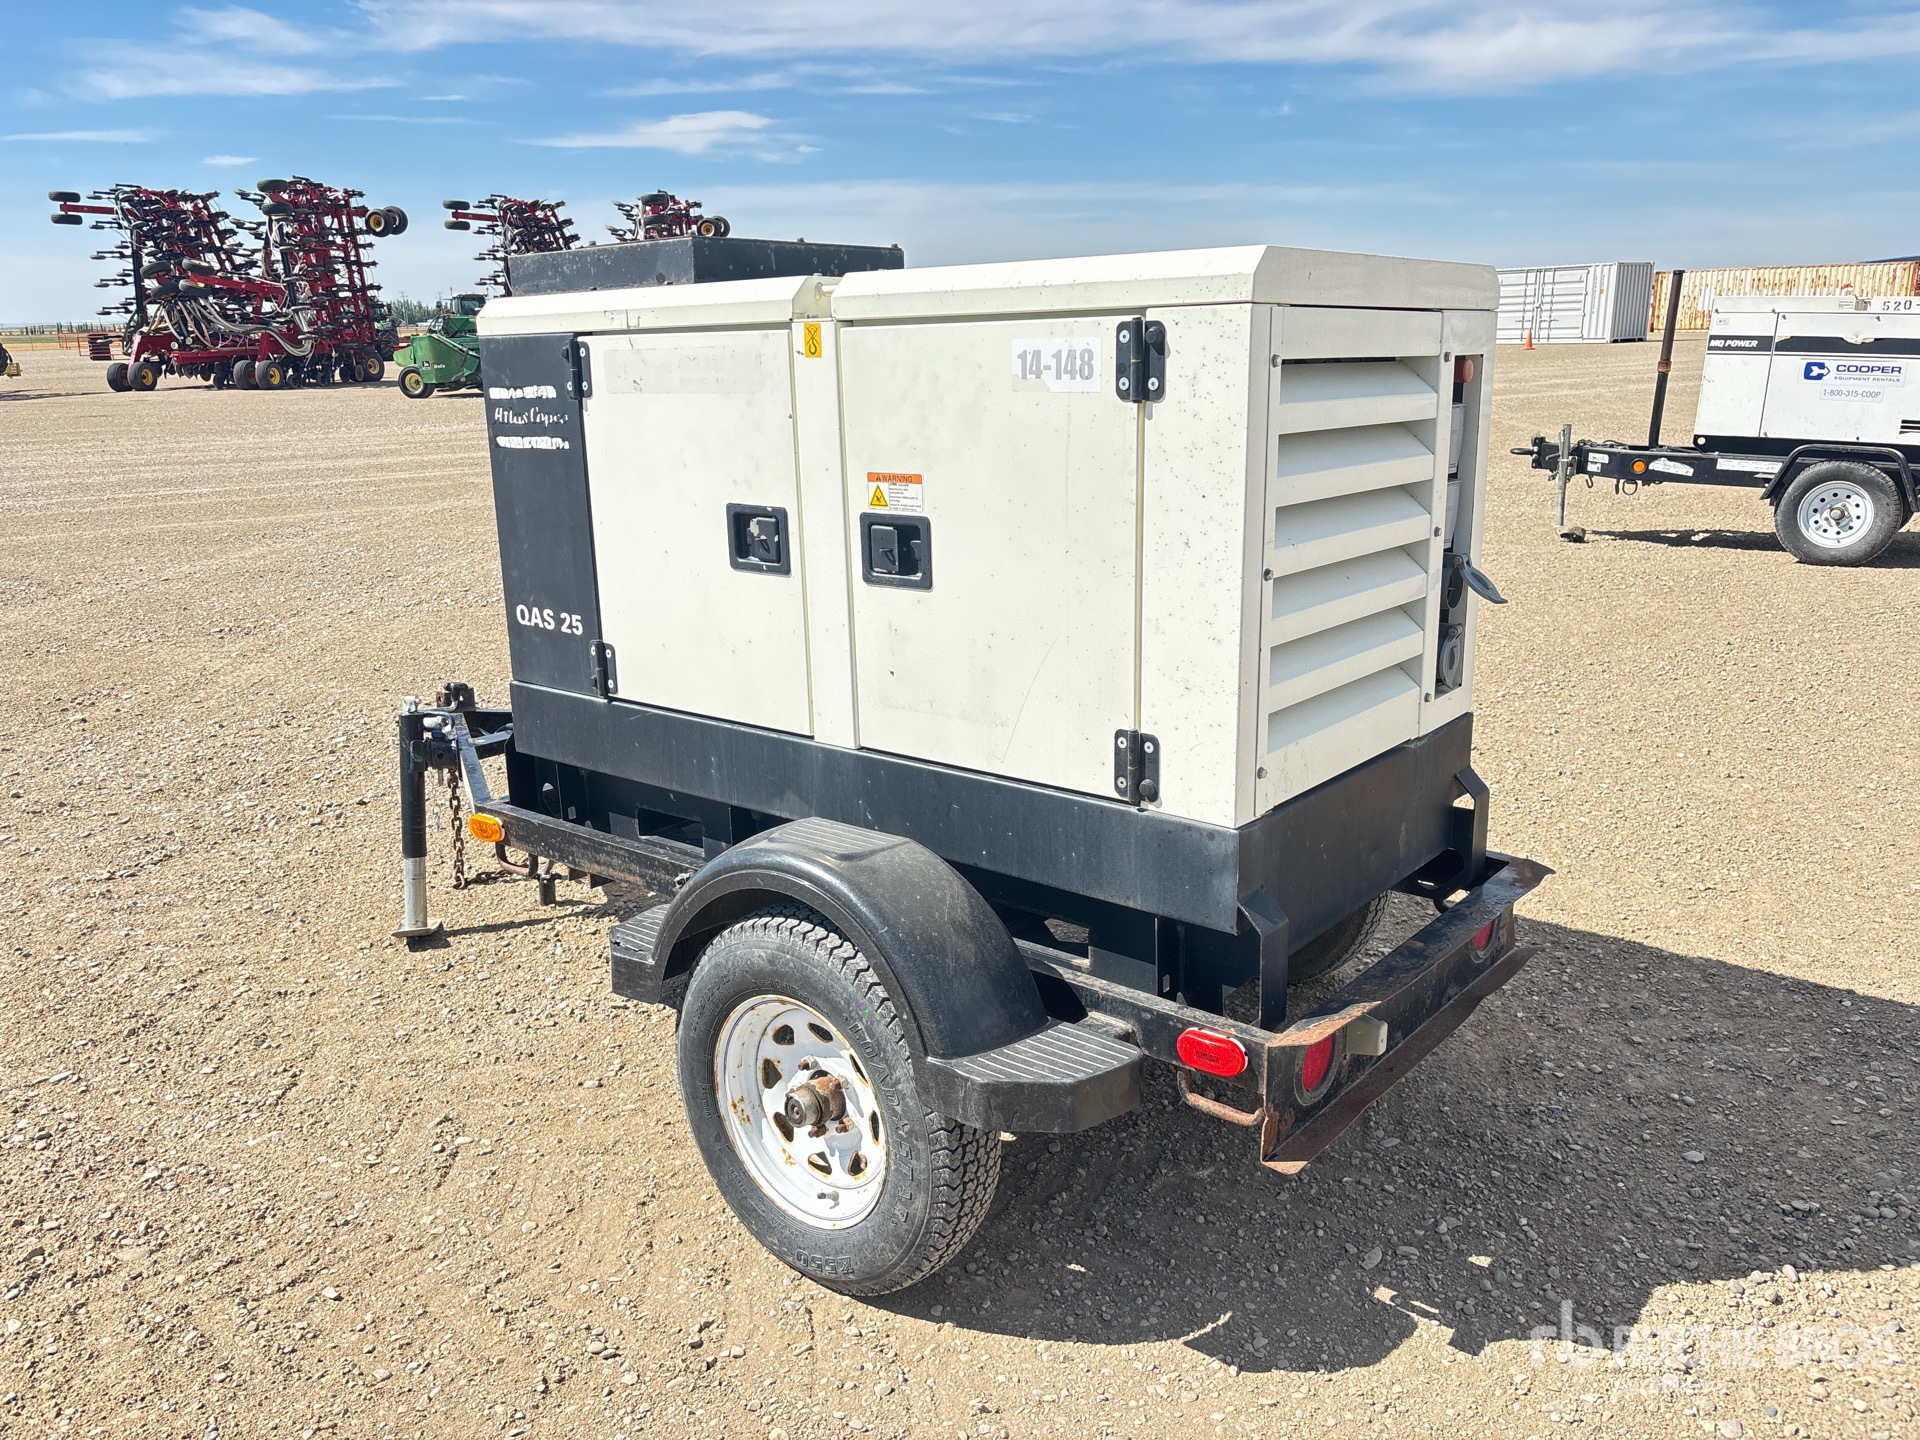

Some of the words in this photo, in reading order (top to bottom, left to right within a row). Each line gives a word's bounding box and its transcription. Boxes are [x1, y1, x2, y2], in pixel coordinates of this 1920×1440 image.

[1709, 339, 1725, 348] MQ
[1725, 339, 1759, 348] POWER
[1017, 348, 1094, 381] 14-148
[1836, 364, 1902, 375] COOPER
[1823, 388, 1881, 399] 1-800-315-COOP
[881, 474, 913, 483] WARNING
[516, 604, 556, 630] QAS
[560, 612, 584, 636] 25
